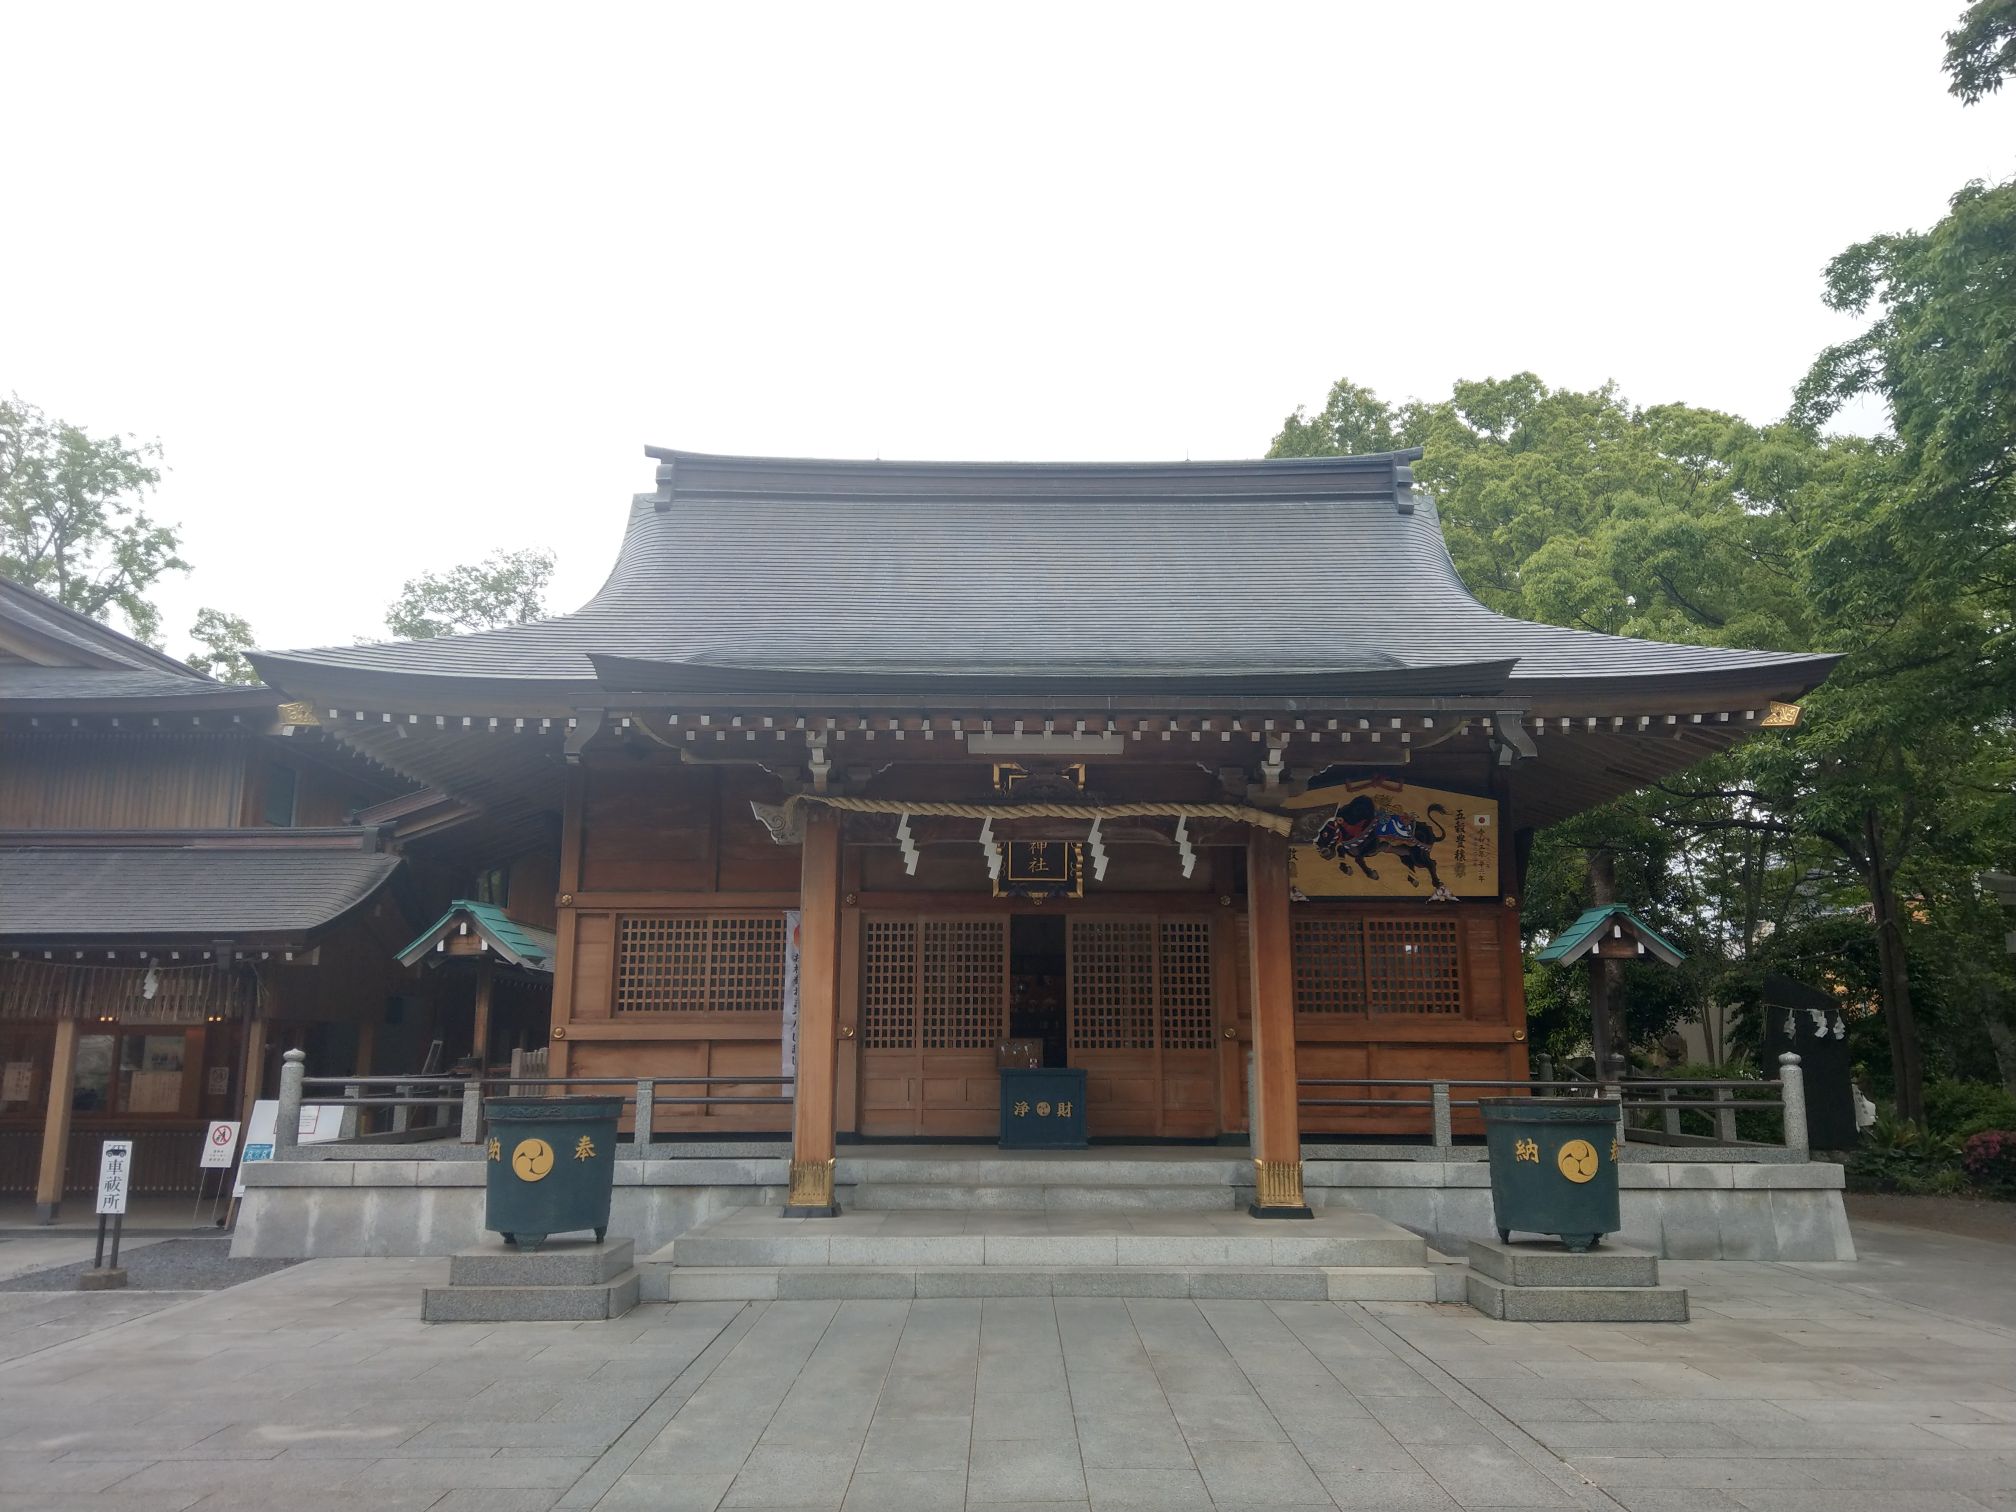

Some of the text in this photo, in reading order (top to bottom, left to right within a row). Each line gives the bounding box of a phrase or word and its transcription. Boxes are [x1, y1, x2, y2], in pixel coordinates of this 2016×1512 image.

[1057, 1101, 1073, 1118] 財
[574, 1135, 597, 1163] 奉
[1514, 1138, 1541, 1164] 納
[103, 1159, 124, 1209] 車祓所
